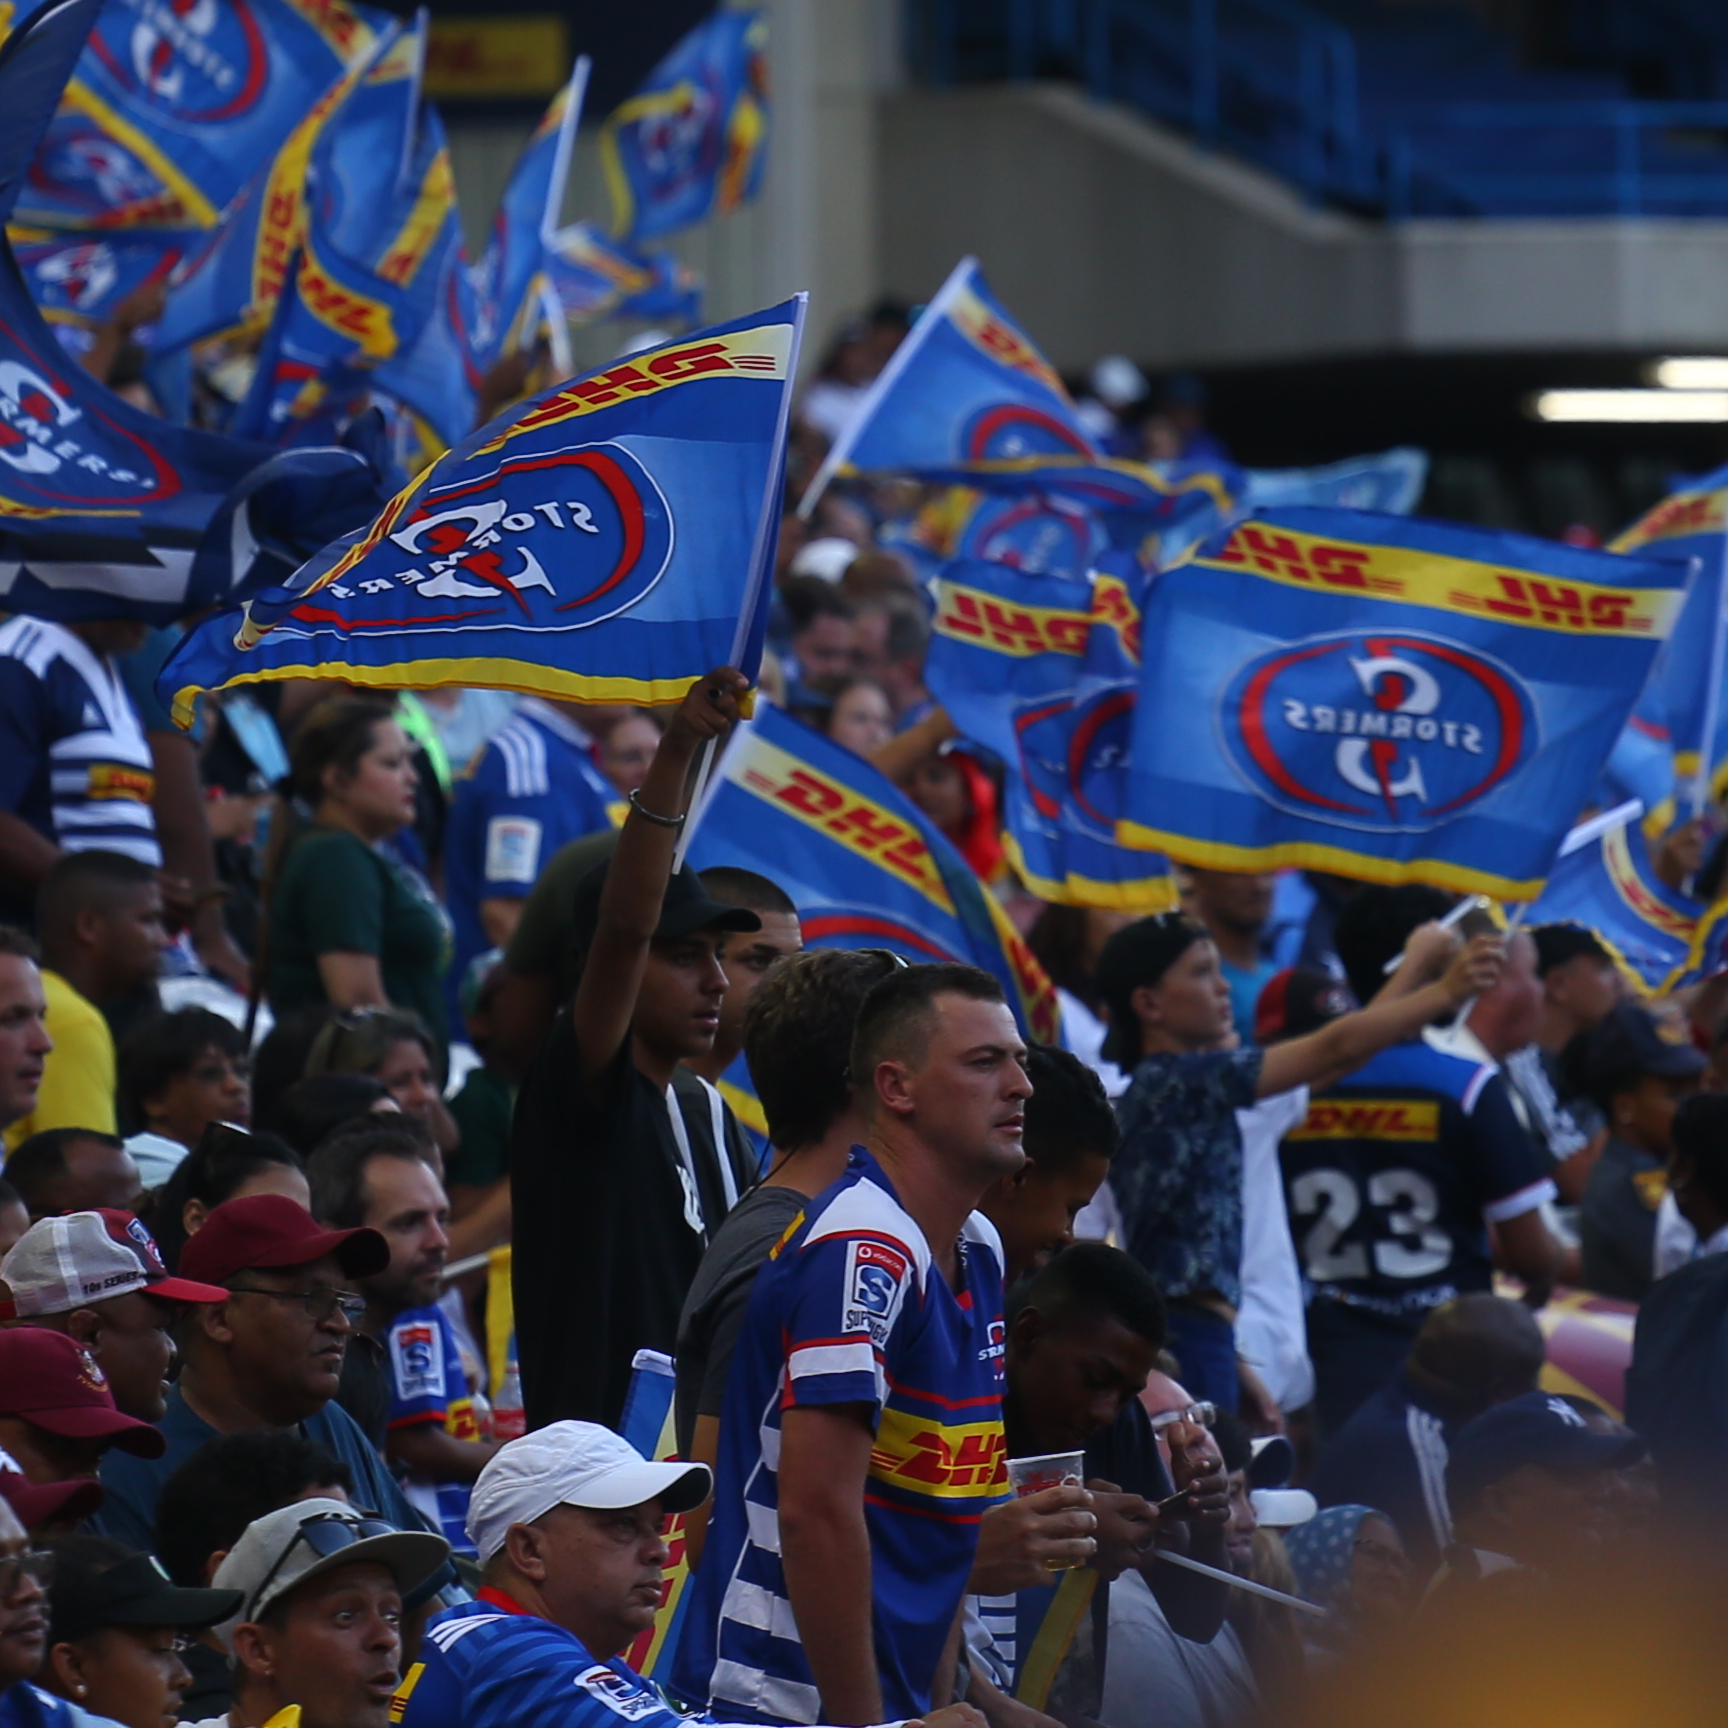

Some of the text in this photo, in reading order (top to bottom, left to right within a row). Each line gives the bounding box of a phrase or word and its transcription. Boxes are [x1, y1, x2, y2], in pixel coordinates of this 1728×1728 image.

[776, 768, 927, 878] DHL
[1308, 1107, 1408, 1132] DHL
[1290, 1166, 1455, 1281] 23
